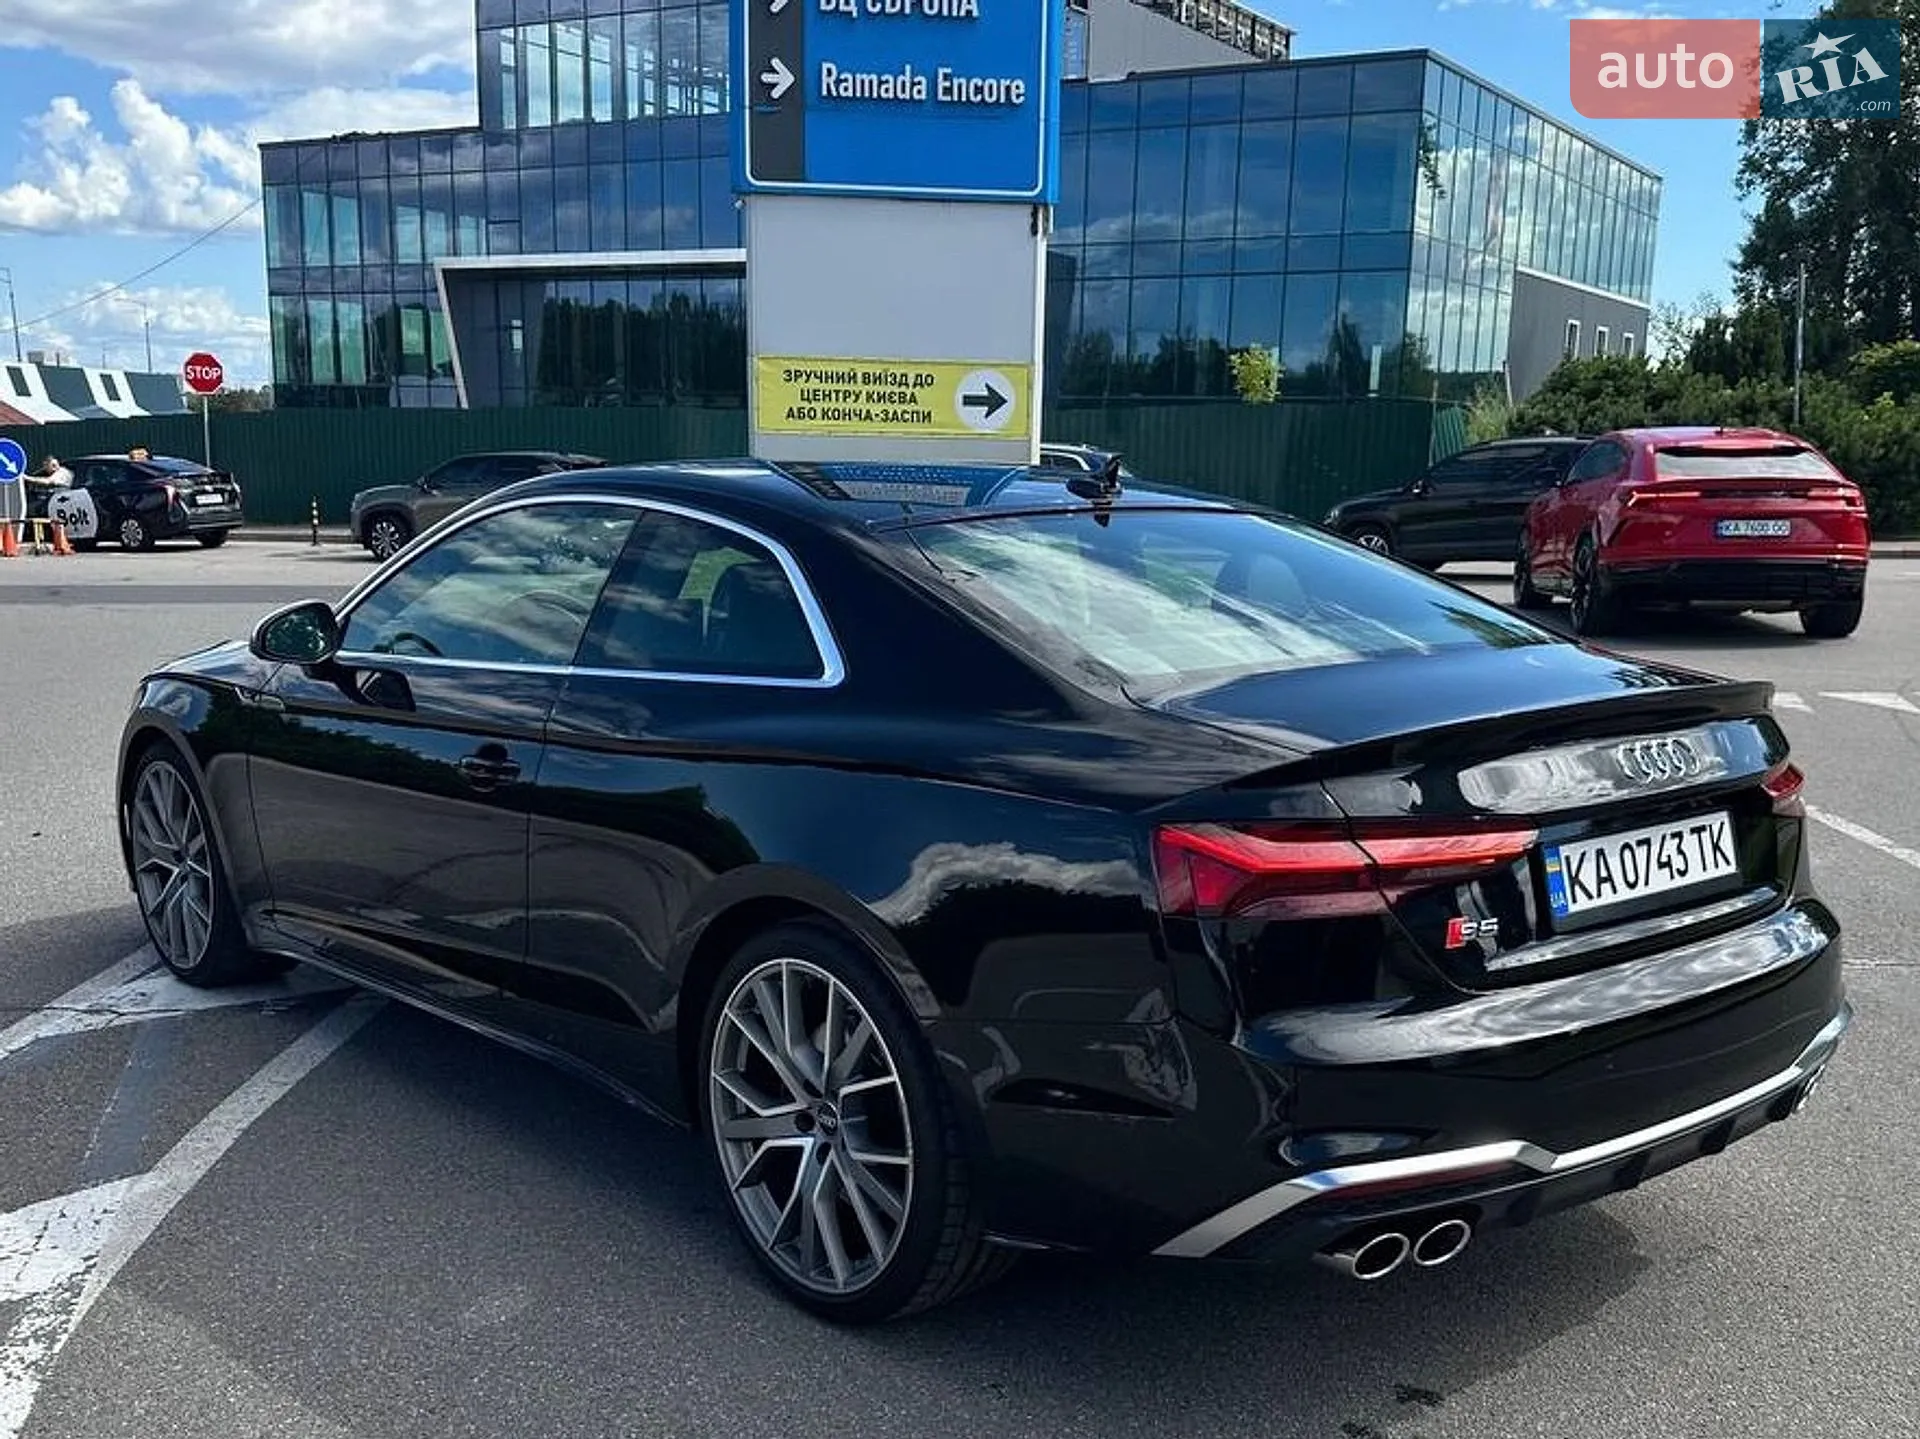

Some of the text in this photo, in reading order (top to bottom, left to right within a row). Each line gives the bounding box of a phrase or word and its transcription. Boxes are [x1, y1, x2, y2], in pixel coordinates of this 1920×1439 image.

[821, 62, 1025, 104] Ramada Encore
[186, 365, 221, 380] STOP
[782, 368, 935, 388] ЗРУЧНИЙ ВИЇЗД ДО
[800, 388, 918, 405] ЦЕНТРУ КИЄВА
[785, 406, 933, 424] АБО КОНЧА-ЗАСПИ
[1564, 820, 1732, 904] KA 0743 TK
